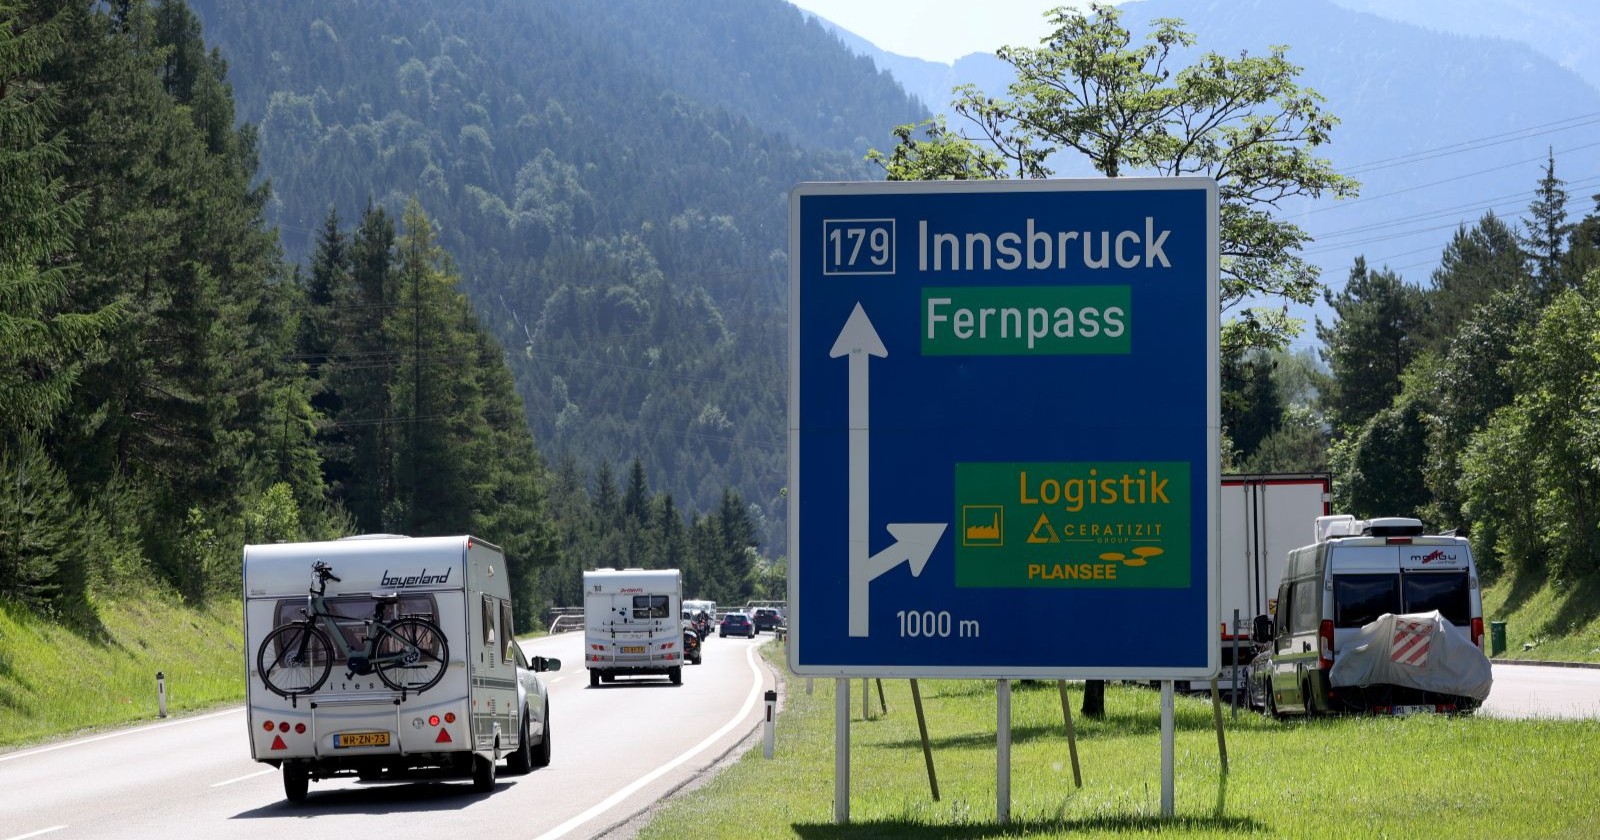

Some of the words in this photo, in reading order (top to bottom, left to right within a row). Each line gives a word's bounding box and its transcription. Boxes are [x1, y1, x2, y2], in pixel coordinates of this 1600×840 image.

[830, 228, 889, 266] 179
[919, 216, 1171, 271] Innsbruck
[927, 298, 1125, 349] Fernpass
[1020, 469, 1169, 512] Logistik
[1064, 523, 1163, 536] CERATIZIT
[380, 567, 452, 589] beyerland
[1029, 564, 1117, 579] PLANSEE
[897, 611, 951, 637] 1000
[959, 620, 979, 637] m
[342, 734, 386, 744] WR-ZN-73
